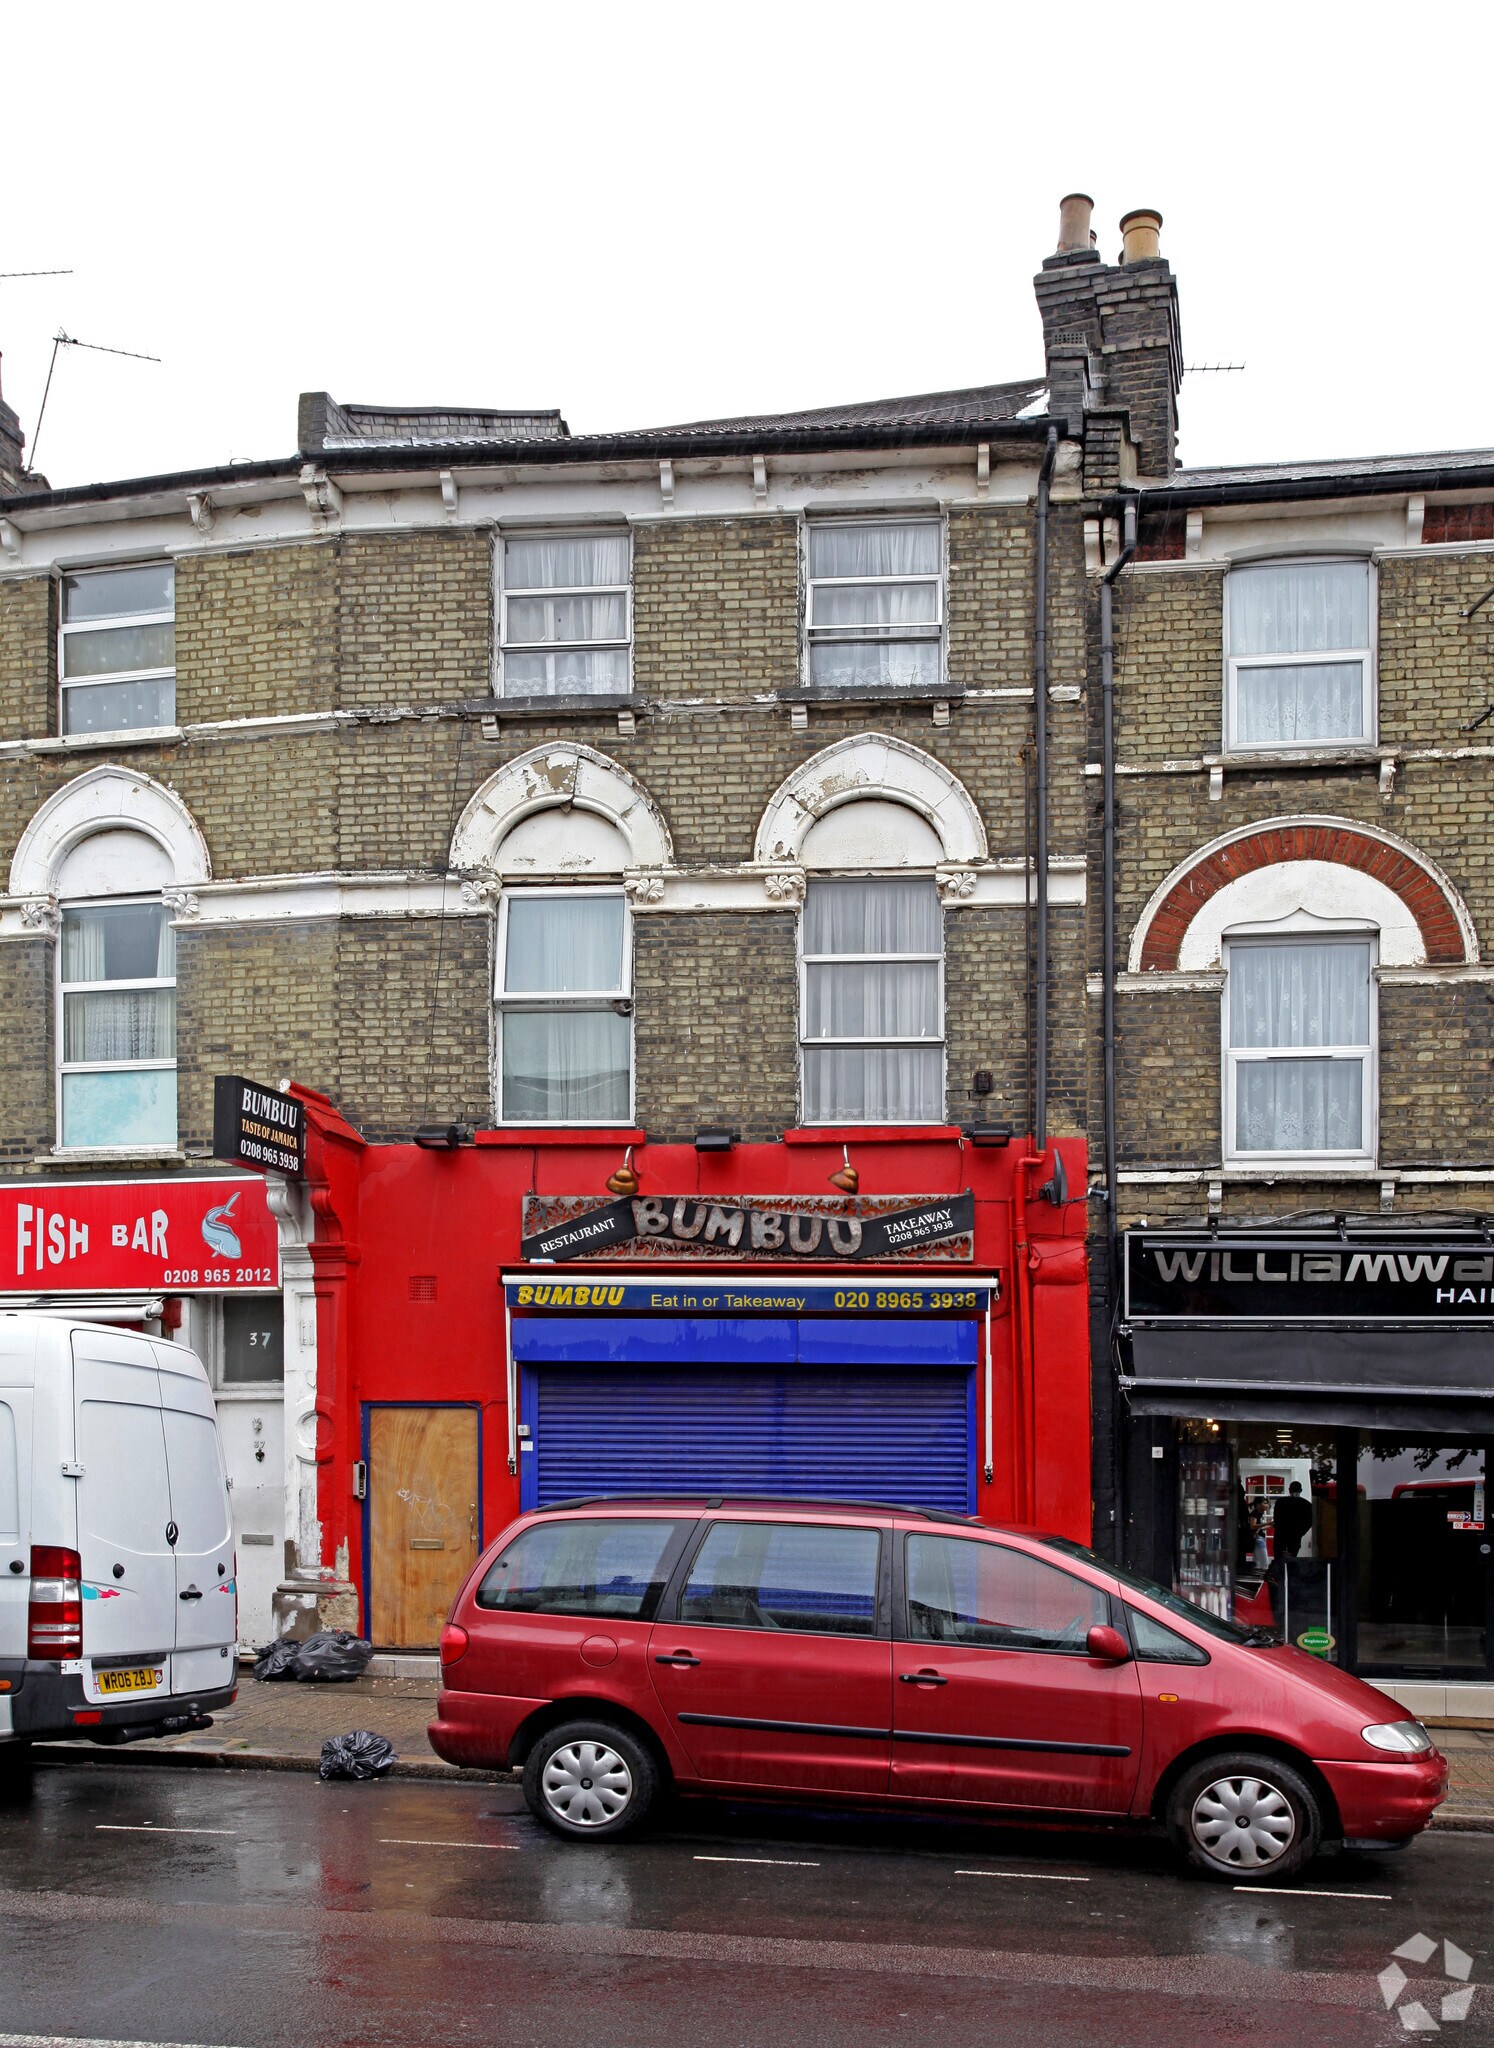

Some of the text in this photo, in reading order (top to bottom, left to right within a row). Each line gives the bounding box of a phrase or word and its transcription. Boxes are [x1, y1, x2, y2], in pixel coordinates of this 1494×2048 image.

[241, 1088, 297, 1128] BUMBUU
[241, 1119, 297, 1150] TASTE OF JAMAICA
[240, 1139, 299, 1171] 0208 965 3938
[631, 1197, 863, 1255] BUMBUU
[883, 1208, 951, 1235] TAKEAWAY
[889, 1220, 954, 1244] 0208 965 3938
[17, 1203, 169, 1275] FISH BAR
[540, 1217, 616, 1254] RESTAURANT
[164, 1268, 271, 1283] 0208 965 2012
[517, 1285, 625, 1305] BUMBUU
[651, 1294, 806, 1311] Eat in or Takeaway
[834, 1292, 977, 1309] 020 8965 3938
[1436, 1288, 1494, 1303] HAI
[249, 1332, 271, 1349] 37
[220, 1647, 229, 1657] GB
[102, 1669, 153, 1689] WR06 ZBJ
